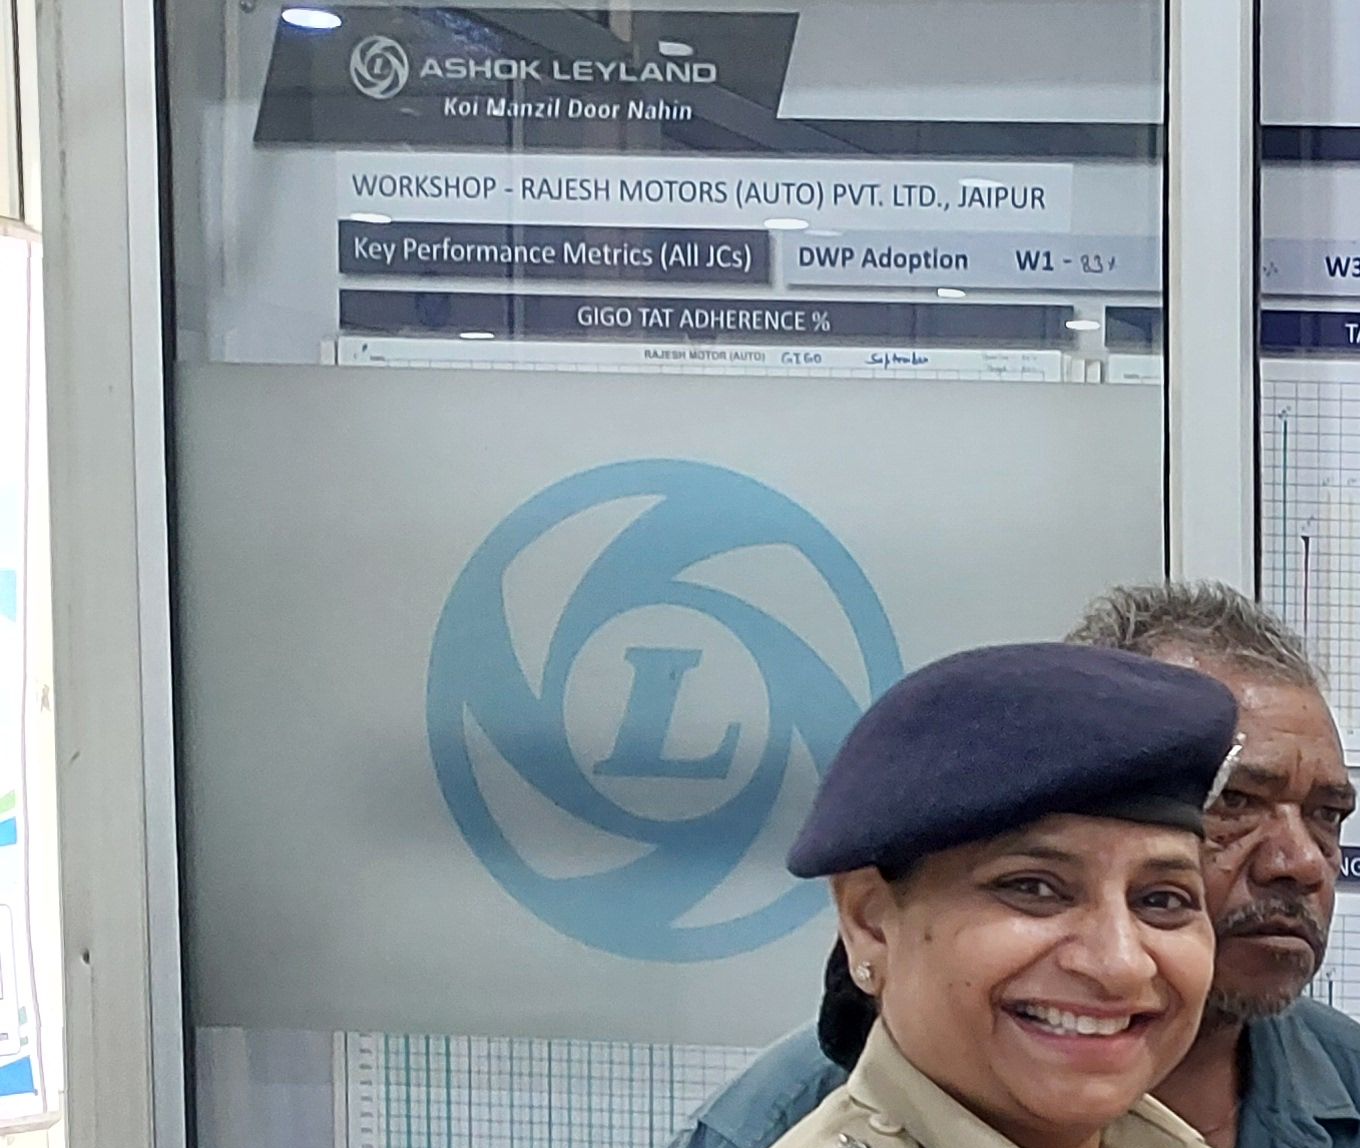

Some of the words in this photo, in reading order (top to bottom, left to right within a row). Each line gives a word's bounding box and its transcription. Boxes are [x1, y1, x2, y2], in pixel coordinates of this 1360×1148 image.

[420, 58, 541, 81] ASHOK
[553, 60, 717, 83] LEYLAND
[444, 98, 479, 117] Koi
[487, 98, 560, 119] Manzil
[568, 100, 618, 119] Door
[628, 100, 692, 121] Nahin
[352, 174, 497, 199] WORKSHOP
[521, 178, 610, 201] RAJESH
[619, 179, 729, 203] MOTORS
[736, 181, 825, 209] (AUTO)
[833, 184, 884, 207] PVT.
[894, 185, 951, 212] LTD.,
[958, 185, 1046, 210] JAIPUR
[354, 237, 397, 265] Key
[404, 237, 556, 264] Performance
[563, 242, 653, 266] Metrics
[660, 243, 699, 271] (All
[705, 244, 752, 273] JCs)
[799, 246, 855, 268] DWP
[861, 246, 968, 274] Adoption
[1016, 250, 1054, 271] W1
[577, 305, 632, 327] GIGO
[638, 308, 674, 328] TAT
[679, 308, 806, 331] ADHERENCE
[812, 311, 831, 332] %
[644, 350, 686, 360] RAJESH
[689, 350, 727, 361] MOTOR
[729, 351, 766, 362] (AUTO)
